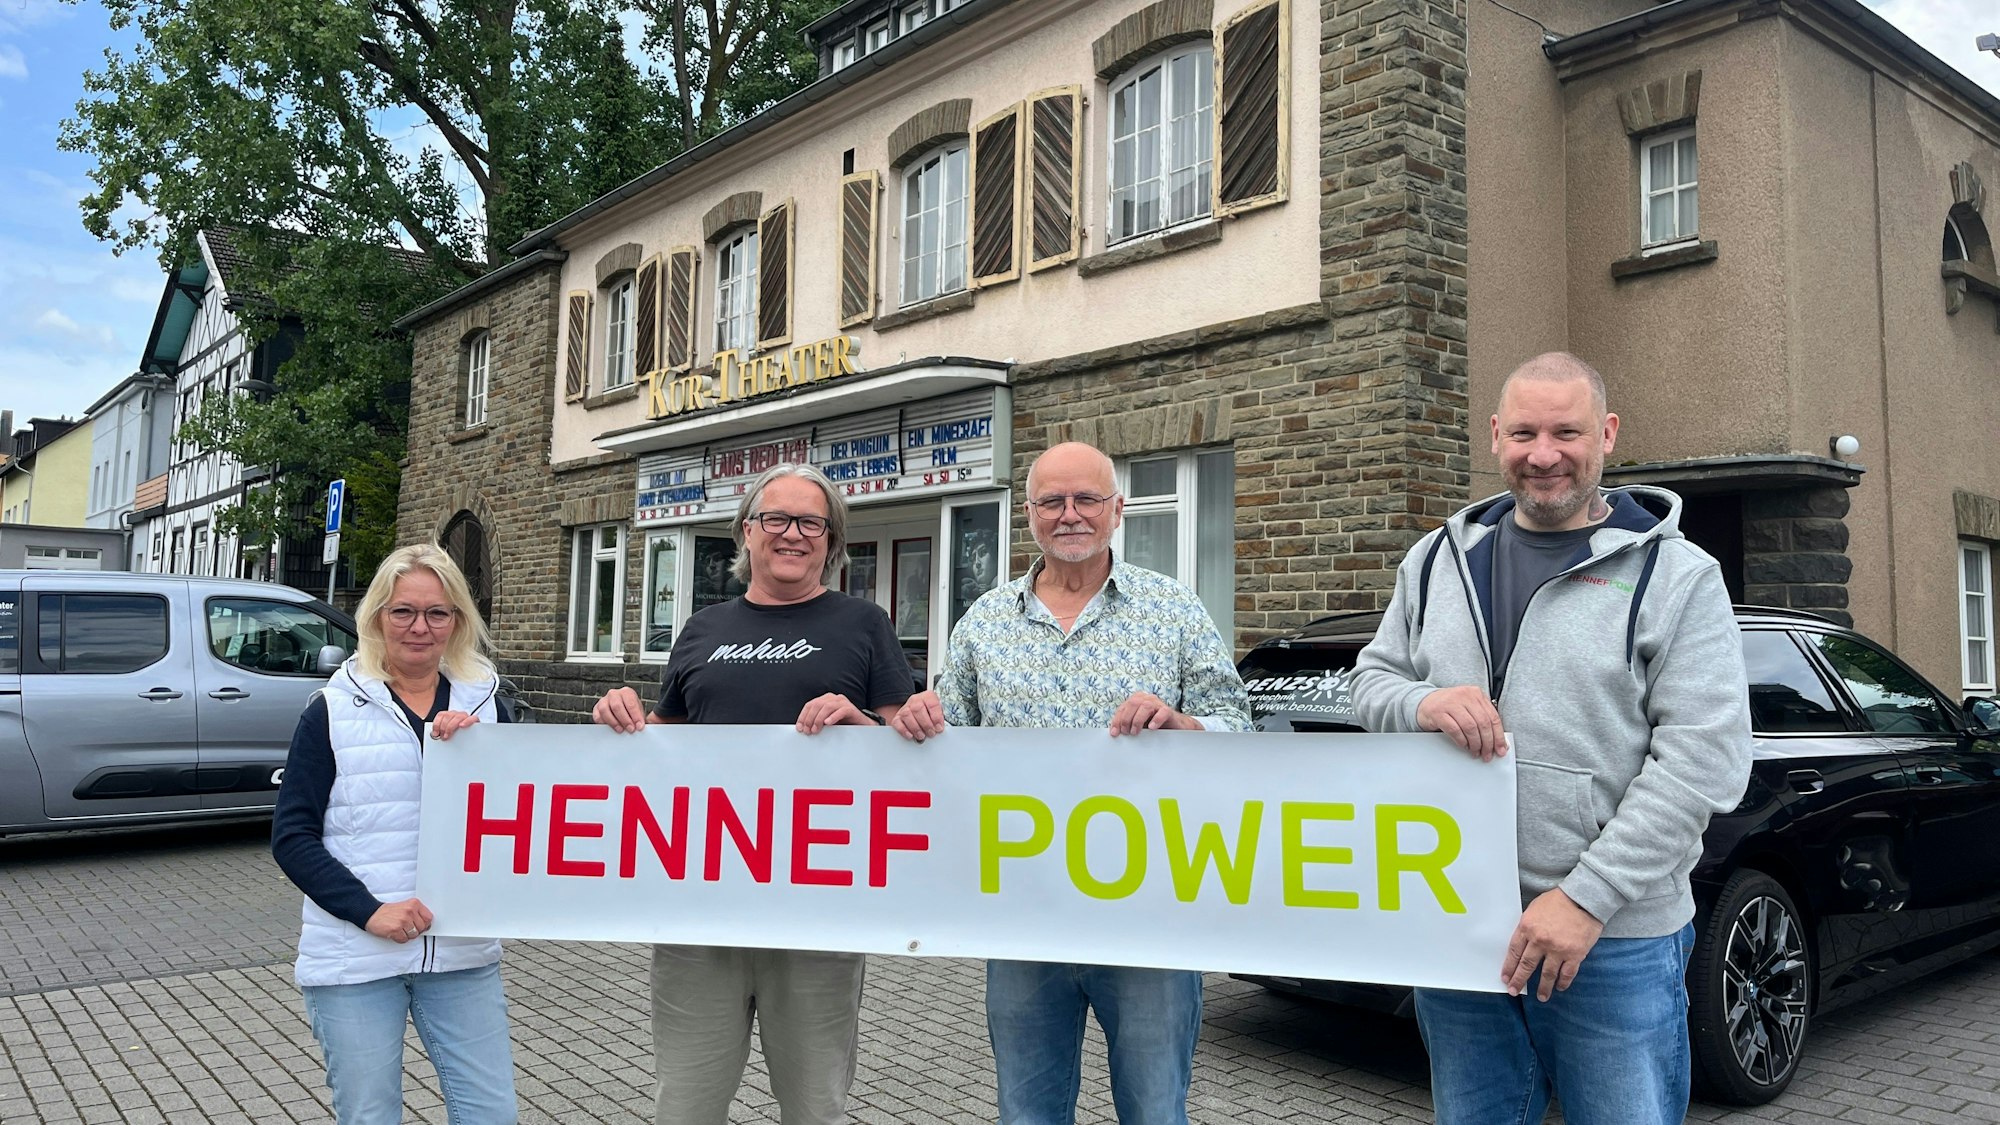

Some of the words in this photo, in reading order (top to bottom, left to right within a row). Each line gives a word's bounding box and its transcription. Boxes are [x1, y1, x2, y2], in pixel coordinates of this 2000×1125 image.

[908, 428, 924, 448] EIN
[932, 415, 992, 444] MINECRAFT
[831, 442, 848, 460] DER
[851, 433, 889, 457] PINGUIN
[932, 446, 957, 466] FILM
[710, 448, 744, 479] LARS
[862, 456, 897, 476] LEBENS
[924, 473, 933, 486] SA
[329, 488, 339, 525] P
[707, 638, 822, 663] mahalo
[464, 783, 931, 888] HENNEF
[980, 795, 1467, 914] POWER
